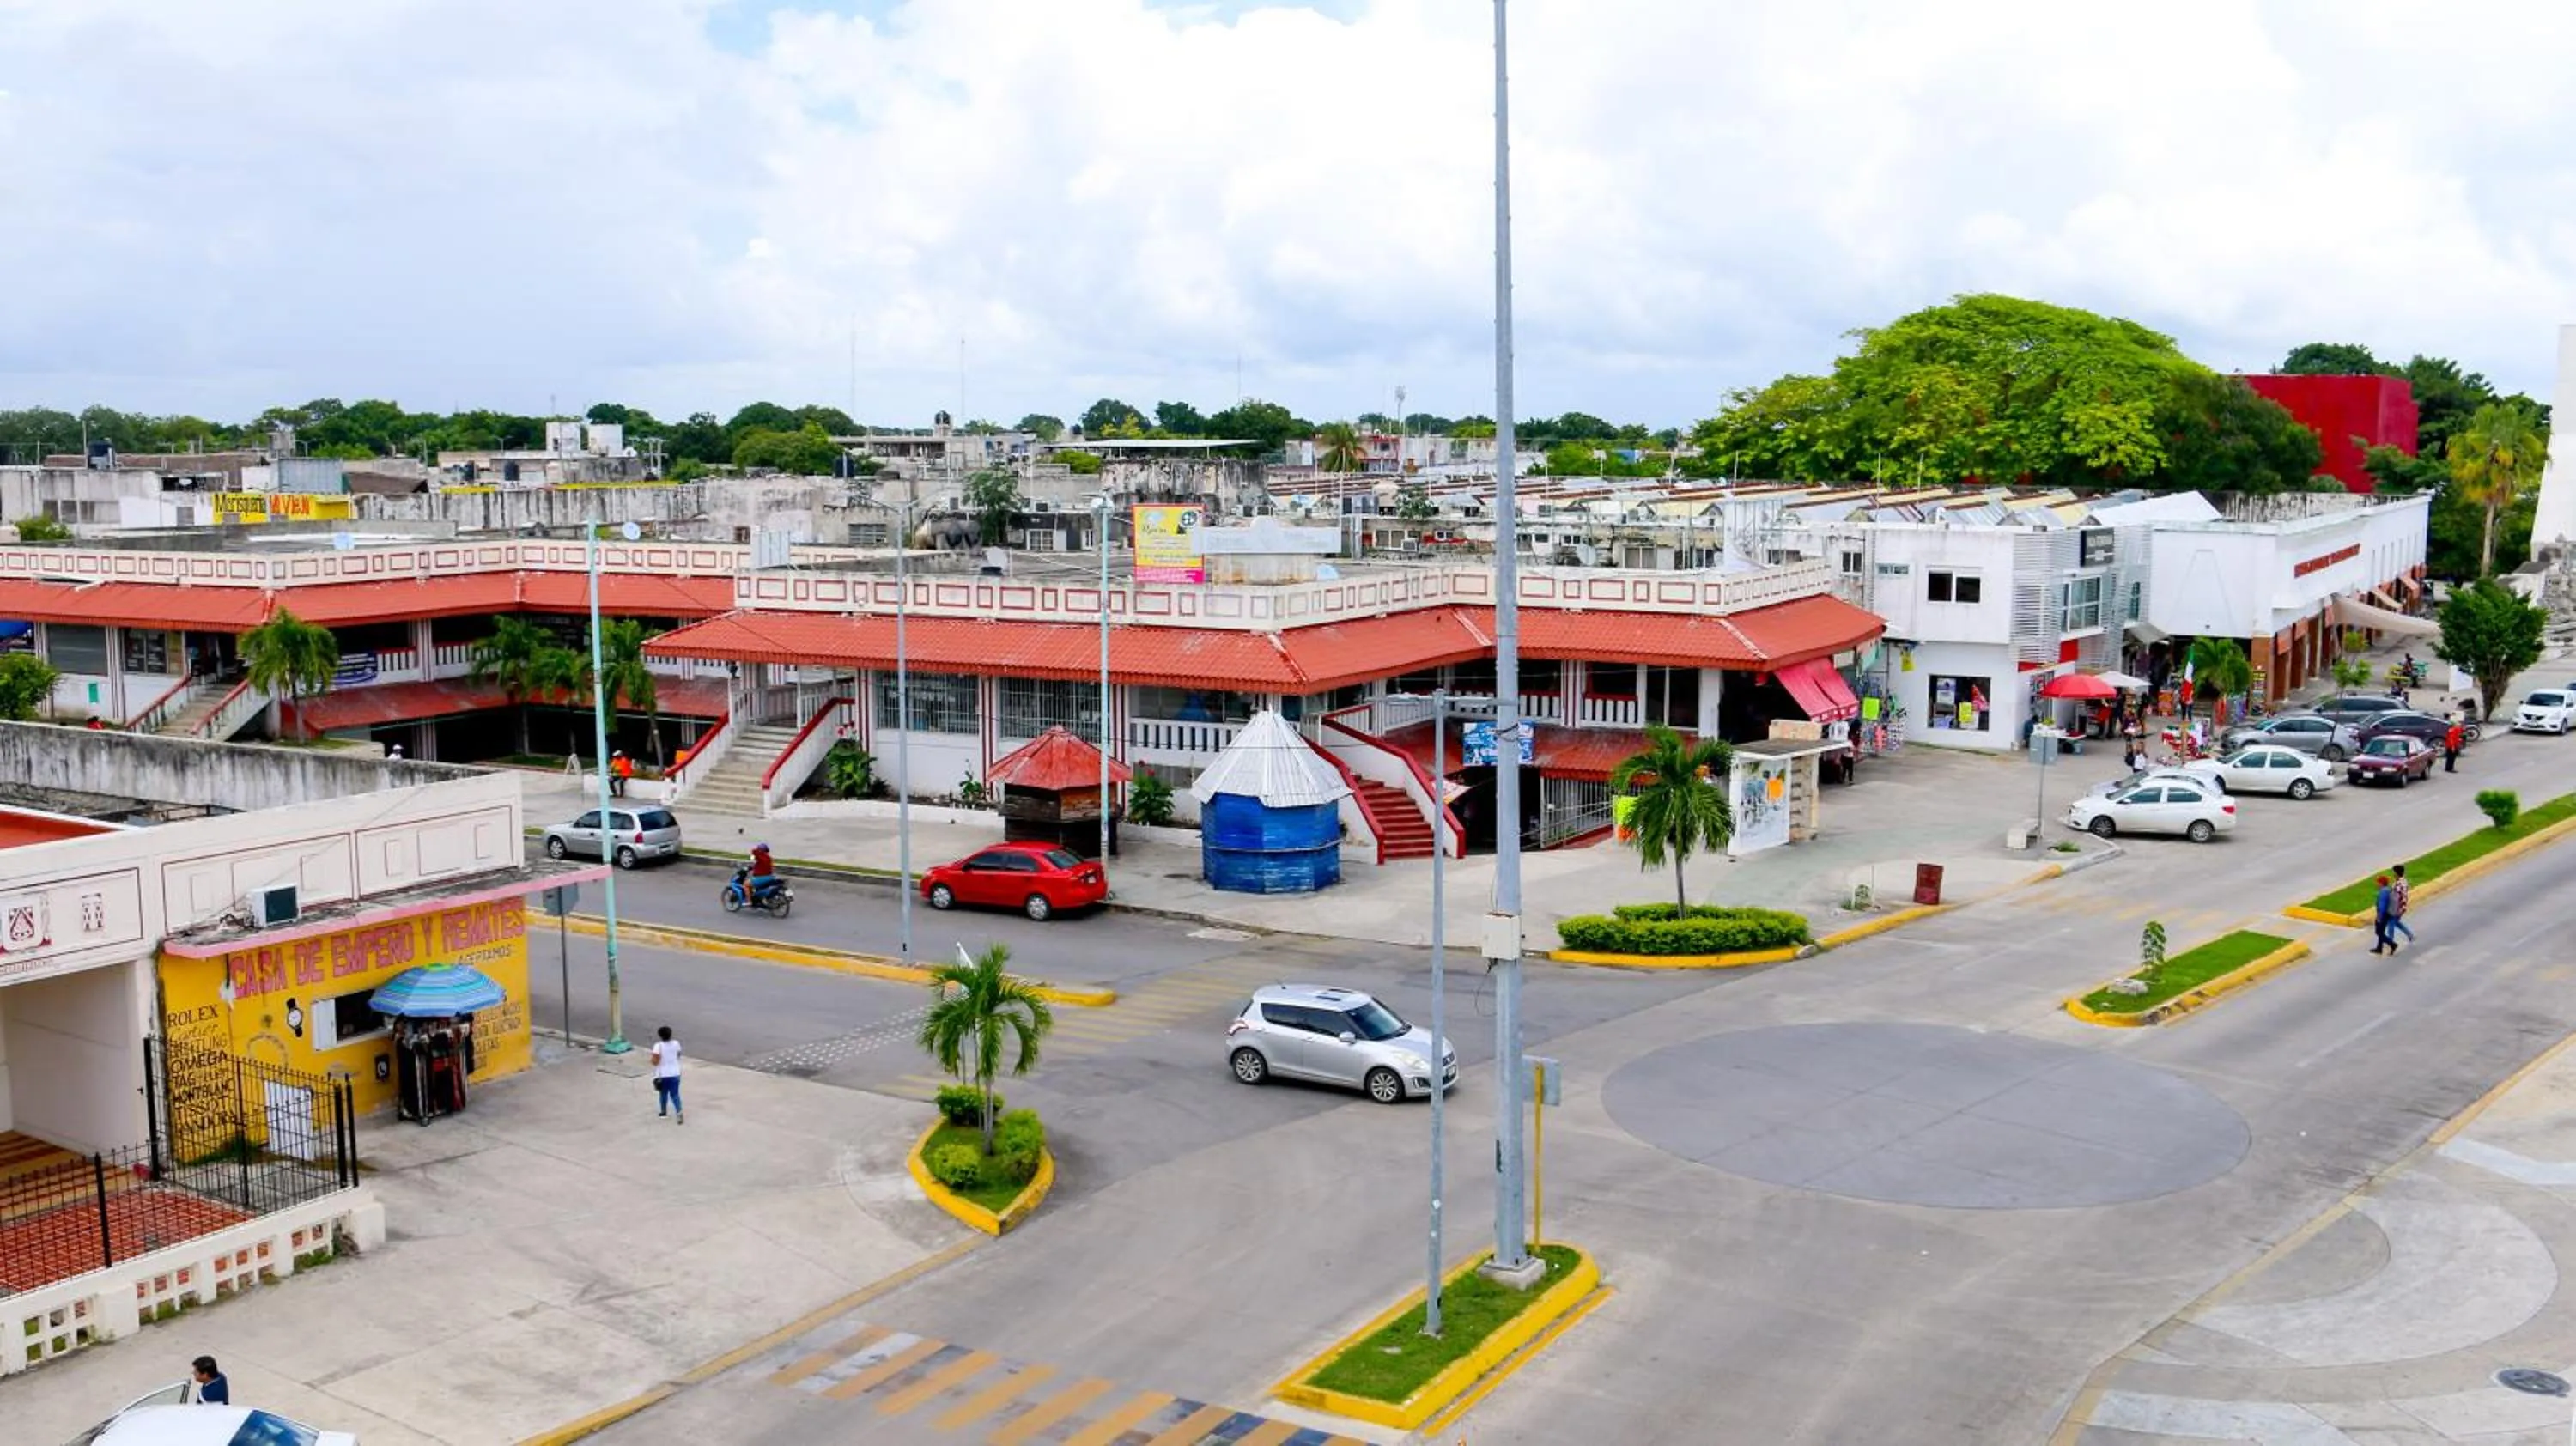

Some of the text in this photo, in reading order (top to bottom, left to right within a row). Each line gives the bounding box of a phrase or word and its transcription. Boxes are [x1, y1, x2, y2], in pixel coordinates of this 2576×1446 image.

[230, 949, 288, 999] CASA
[295, 937, 324, 986] DE
[422, 915, 434, 956] Y
[441, 896, 526, 953] REMATES
[167, 1004, 219, 1028] ROLEX
[171, 1050, 228, 1074] OMEGA
